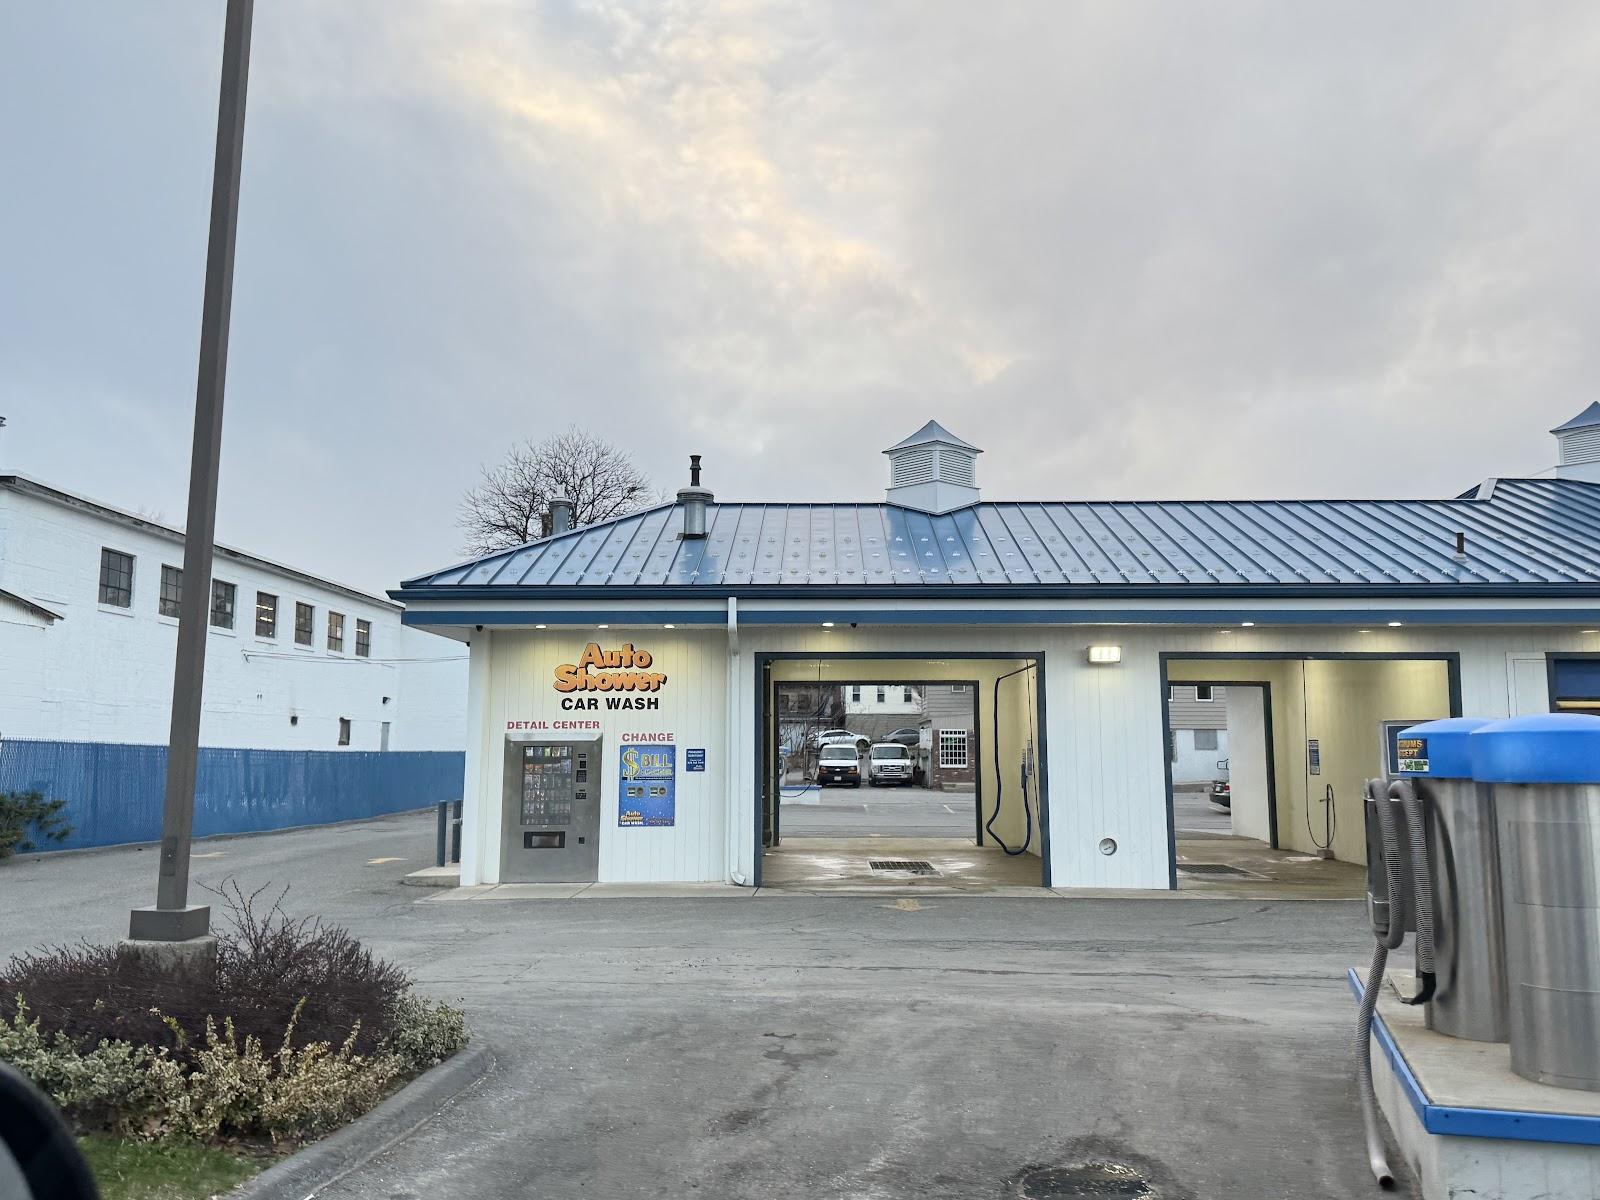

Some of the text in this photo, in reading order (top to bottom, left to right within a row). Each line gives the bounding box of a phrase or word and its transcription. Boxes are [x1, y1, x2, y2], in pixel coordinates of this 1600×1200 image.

[579, 643, 653, 669] Auto
[553, 664, 667, 693] Shower
[561, 698, 659, 710] CAR WASH
[507, 720, 600, 730] DETAIL CENTER
[622, 732, 674, 742] CHANGE
[642, 754, 673, 767] BILL
